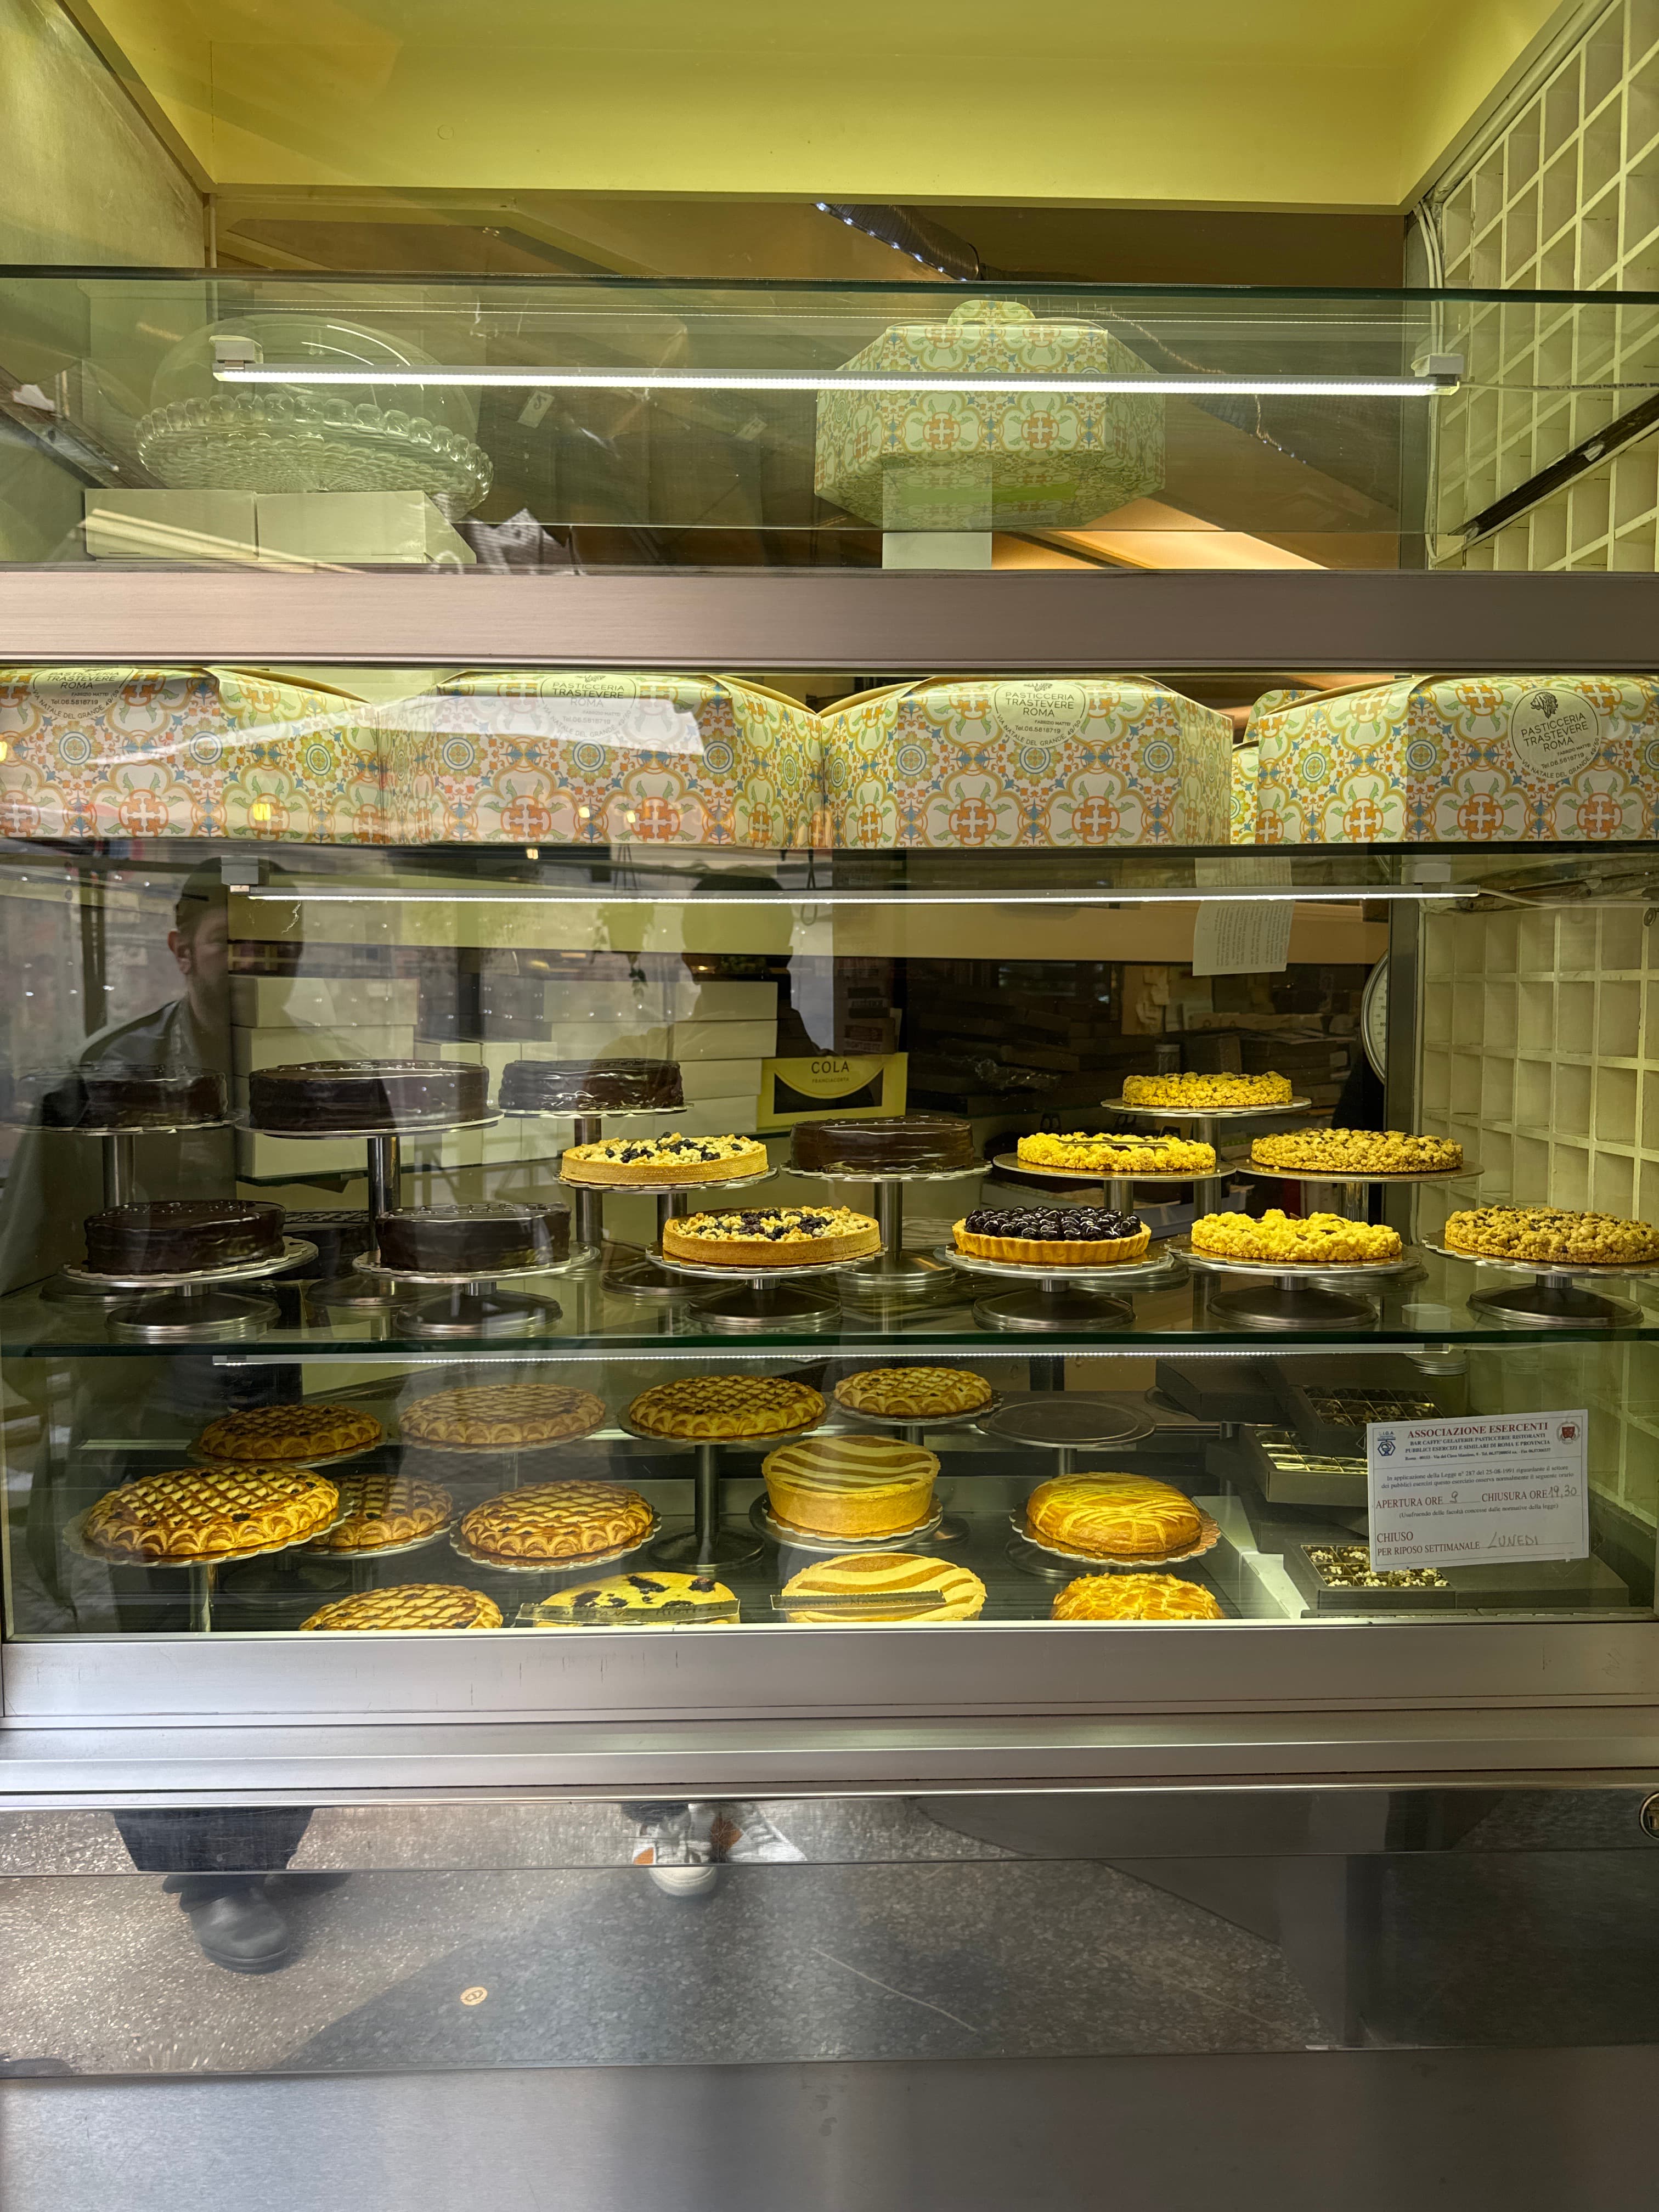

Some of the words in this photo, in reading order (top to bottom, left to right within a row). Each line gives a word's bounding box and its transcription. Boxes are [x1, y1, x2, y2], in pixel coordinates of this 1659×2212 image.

[553, 682, 624, 691] PASTICCERIA
[553, 689, 624, 698] TRASTEVERE
[40, 699, 61, 716] NATALE
[106, 690, 119, 706] 49/50
[571, 698, 603, 707] ROMA
[1006, 692, 1074, 701] PASTICCERIA
[1006, 698, 1074, 709] TRASTEVERE
[1023, 708, 1054, 717] ROMA
[551, 716, 573, 733] NATALE
[1004, 725, 1024, 742] NATALE
[1068, 720, 1081, 735] 49/50
[1015, 725, 1060, 733] Tel.06.5818719
[1521, 713, 1586, 738] PASTICCERIA
[1523, 721, 1588, 747] TRASTEVERE
[1543, 736, 1574, 752] ROMA
[1558, 748, 1576, 756] FABRIZIO
[1531, 767, 1554, 778] NATALE
[1590, 738, 1599, 755] 49/50
[1541, 753, 1584, 769] Tel.06.5818719
[811, 1060, 849, 1074] COLA
[1408, 1426, 1486, 1438] ASSOCIAZIONE
[1489, 1422, 1548, 1434] ESERCENTI
[1376, 1498, 1423, 1509] APERTURA
[1425, 1496, 1443, 1506] ORE
[1450, 1491, 1458, 1503] 9
[1482, 1491, 1527, 1502] CHIUSURA
[1530, 1489, 1548, 1499] ORE
[1548, 1485, 1577, 1499] 19,30
[1377, 1531, 1413, 1543] CHIUSO
[1378, 1548, 1392, 1556] PER
[1394, 1545, 1423, 1555] RIPOSO
[1425, 1542, 1480, 1553] SETTIMANALE
[1487, 1531, 1538, 1549] LUNEDI
